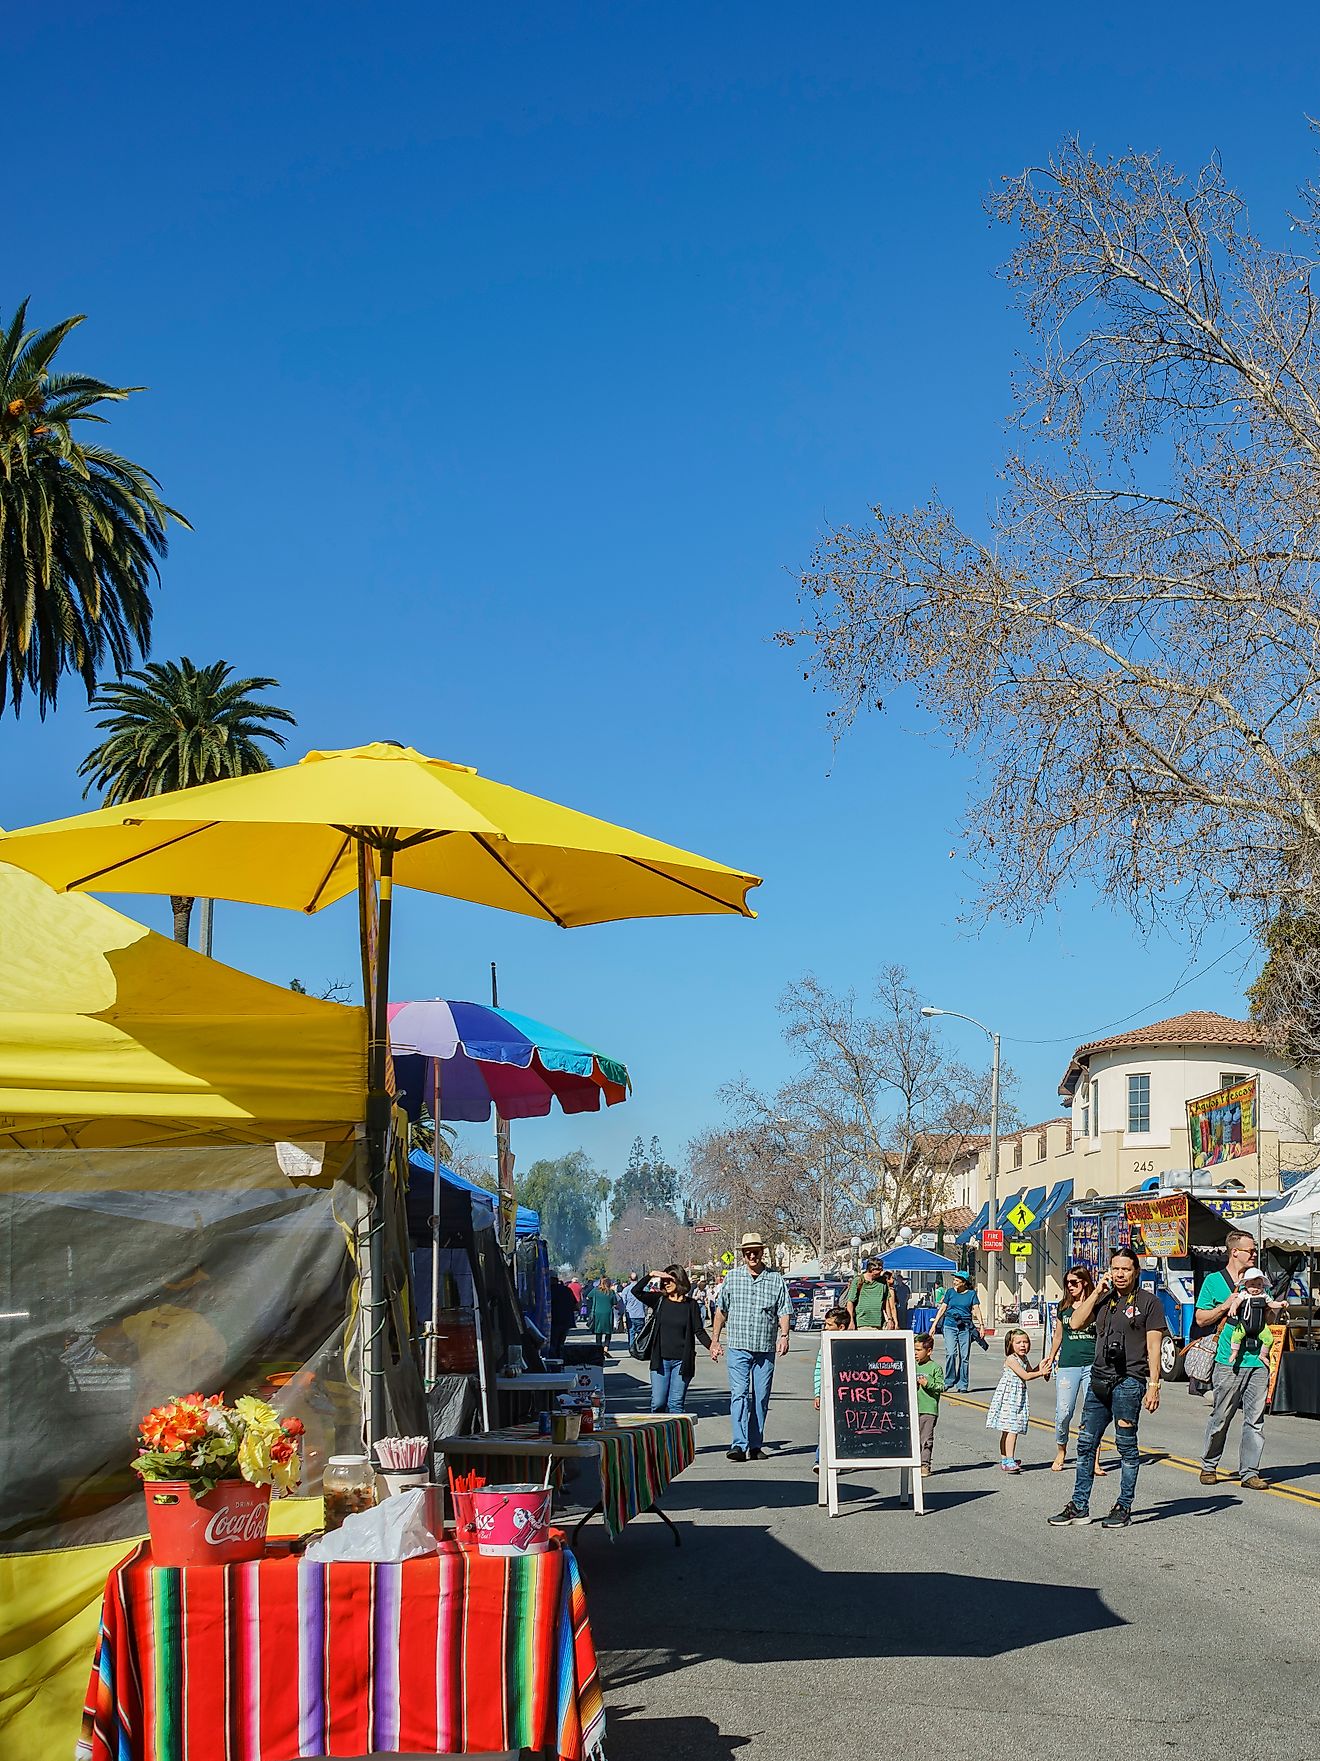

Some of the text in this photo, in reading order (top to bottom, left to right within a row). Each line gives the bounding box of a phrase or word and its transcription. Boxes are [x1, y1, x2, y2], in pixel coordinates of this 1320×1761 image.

[1133, 1160, 1154, 1173] 245
[839, 1371, 879, 1385] WOOD
[838, 1386, 893, 1406] FIRED
[845, 1409, 894, 1430] PIZZA
